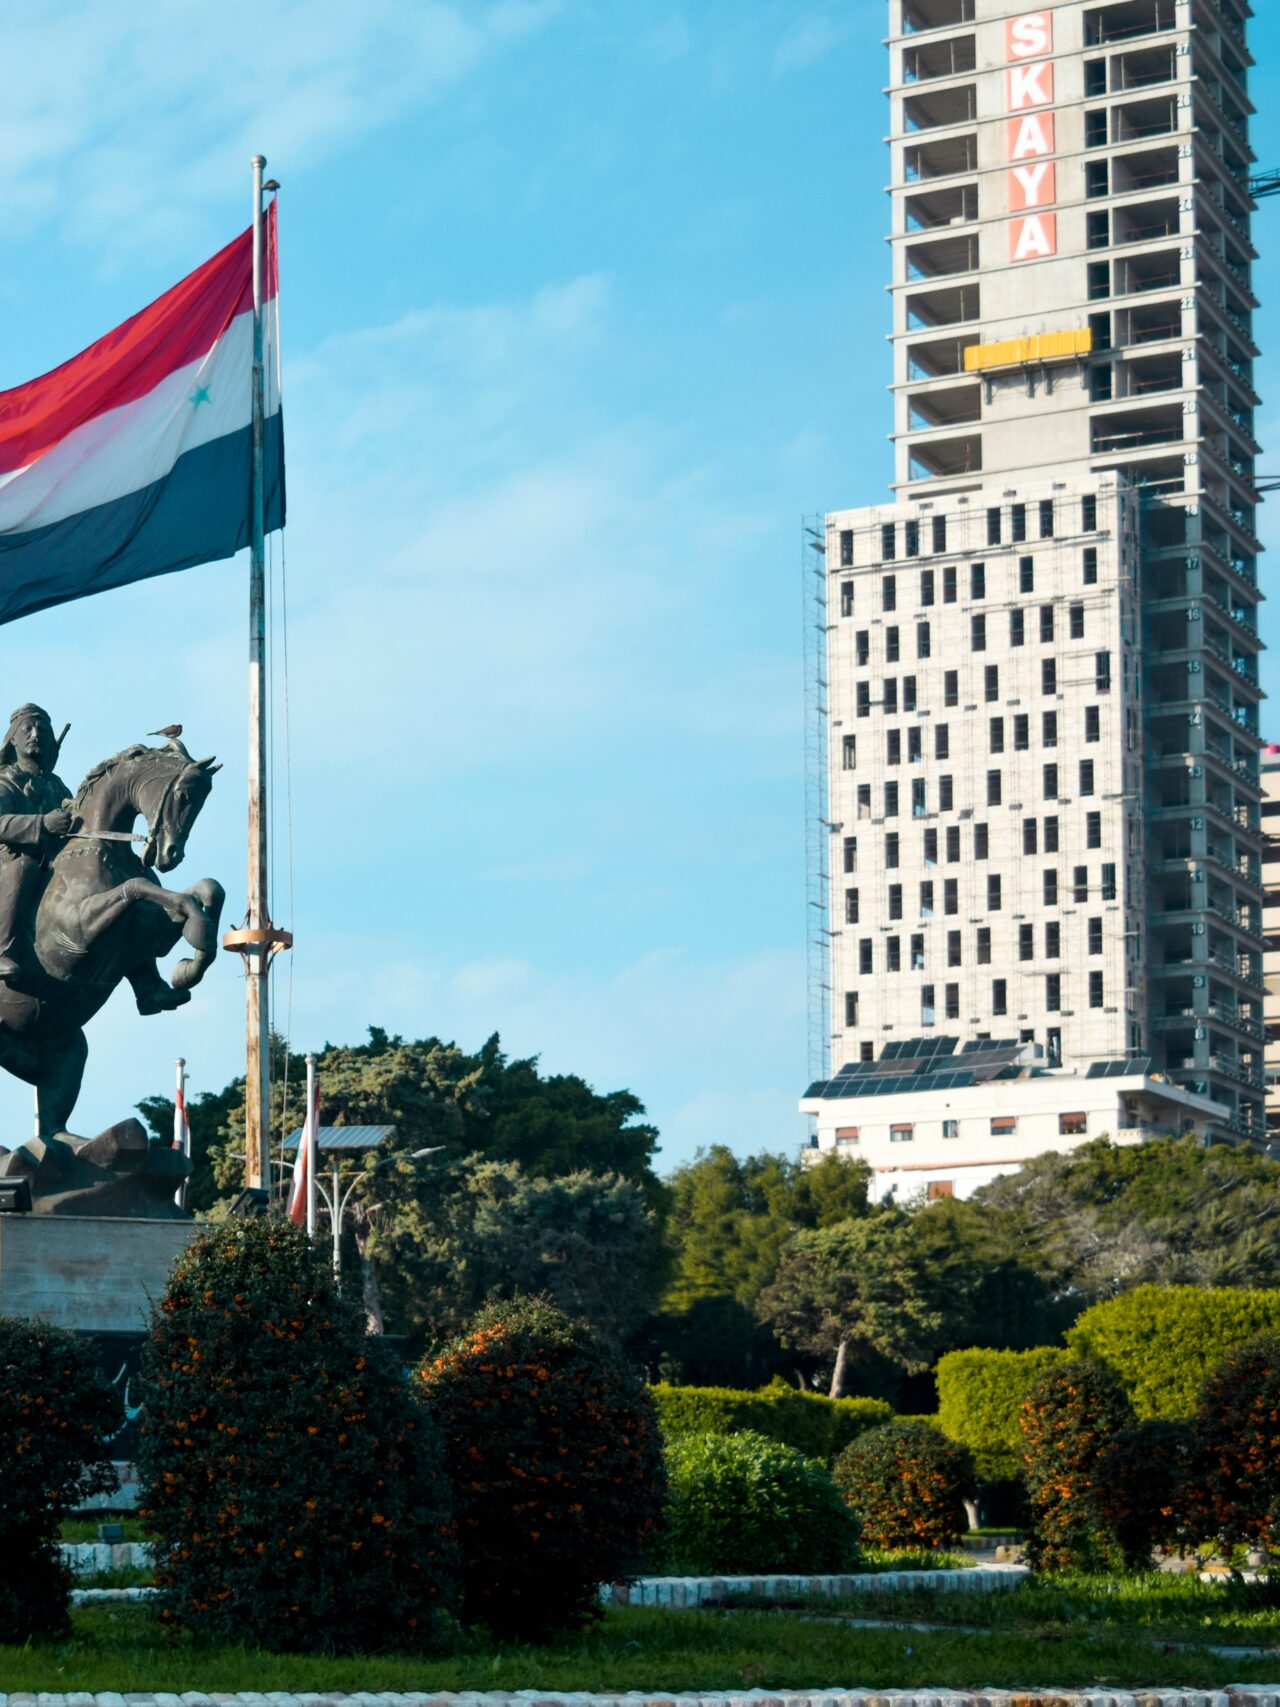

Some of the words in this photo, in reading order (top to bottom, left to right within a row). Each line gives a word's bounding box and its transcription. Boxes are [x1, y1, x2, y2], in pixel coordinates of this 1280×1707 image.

[1010, 14, 1051, 261] SKAYA
[1180, 247, 1193, 259] 23
[1181, 297, 1194, 309] 22
[1182, 348, 1195, 360] 21
[1183, 402, 1196, 413] 20
[1184, 453, 1197, 464] 19
[1185, 558, 1198, 569] 17
[1186, 609, 1200, 621] 16
[1187, 661, 1200, 672] 15
[1190, 819, 1203, 829] 12
[1191, 924, 1204, 935] 10
[1193, 976, 1203, 987] 9
[1194, 1028, 1204, 1040] 8
[1195, 1081, 1205, 1092] 7
